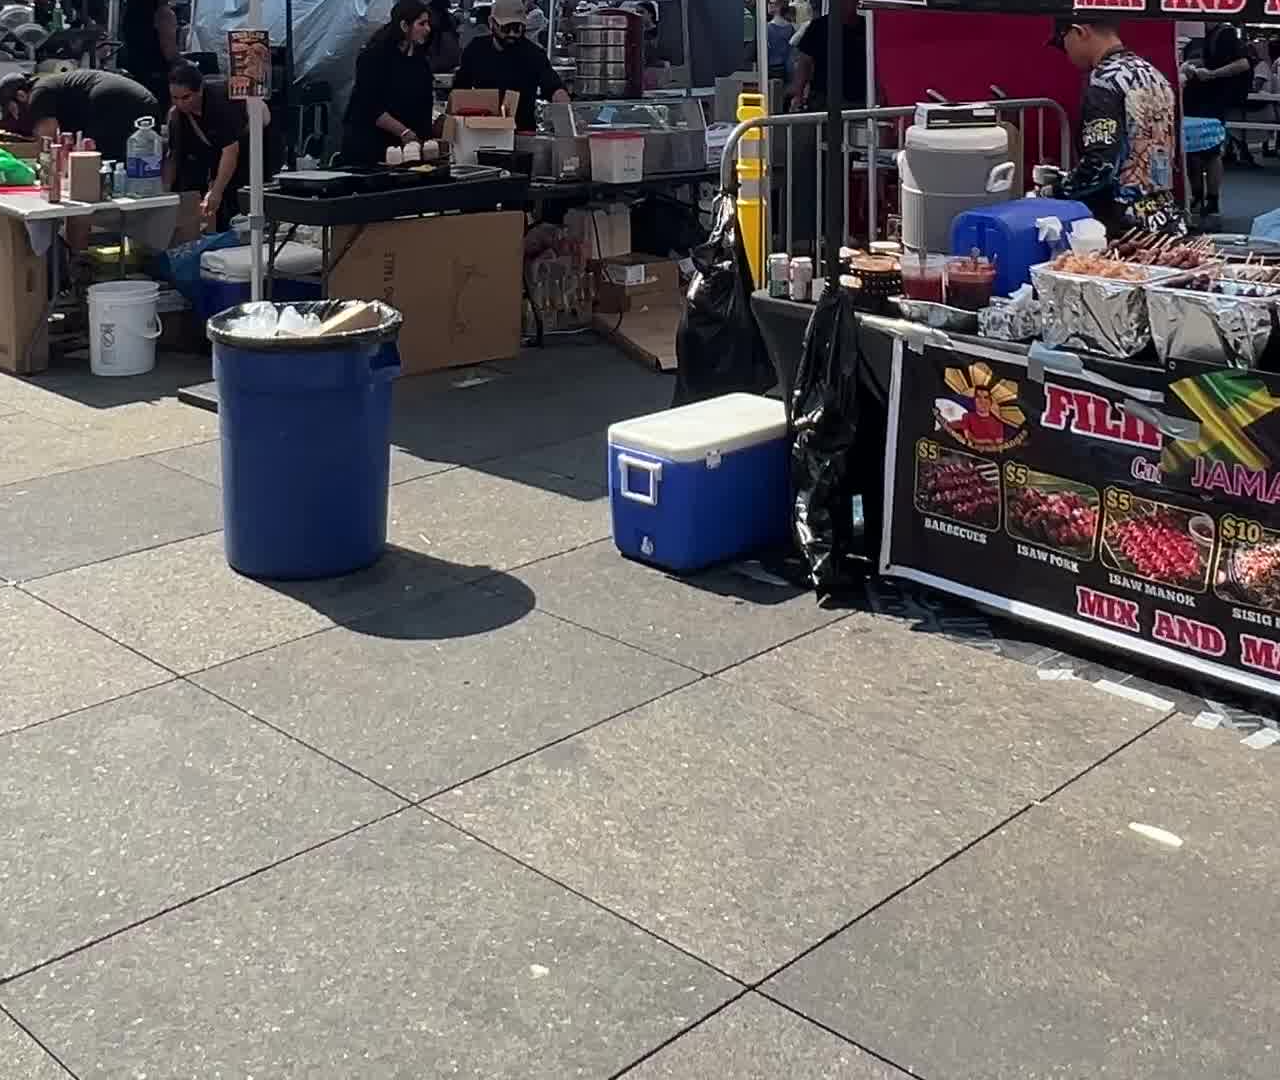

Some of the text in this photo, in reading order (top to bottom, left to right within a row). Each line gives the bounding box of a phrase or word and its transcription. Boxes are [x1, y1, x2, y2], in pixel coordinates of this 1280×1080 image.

[918, 441, 938, 460] $5
[1006, 463, 1027, 485] $5
[1106, 489, 1130, 511] $5
[924, 518, 987, 545] BARBECUES
[1222, 517, 1262, 544] $10
[1017, 544, 1049, 565] ISAW
[1108, 572, 1197, 608] ISAW MANOK
[1076, 585, 1139, 633] MIX
[1152, 609, 1226, 657] AND
[1232, 607, 1272, 630] SISIG
